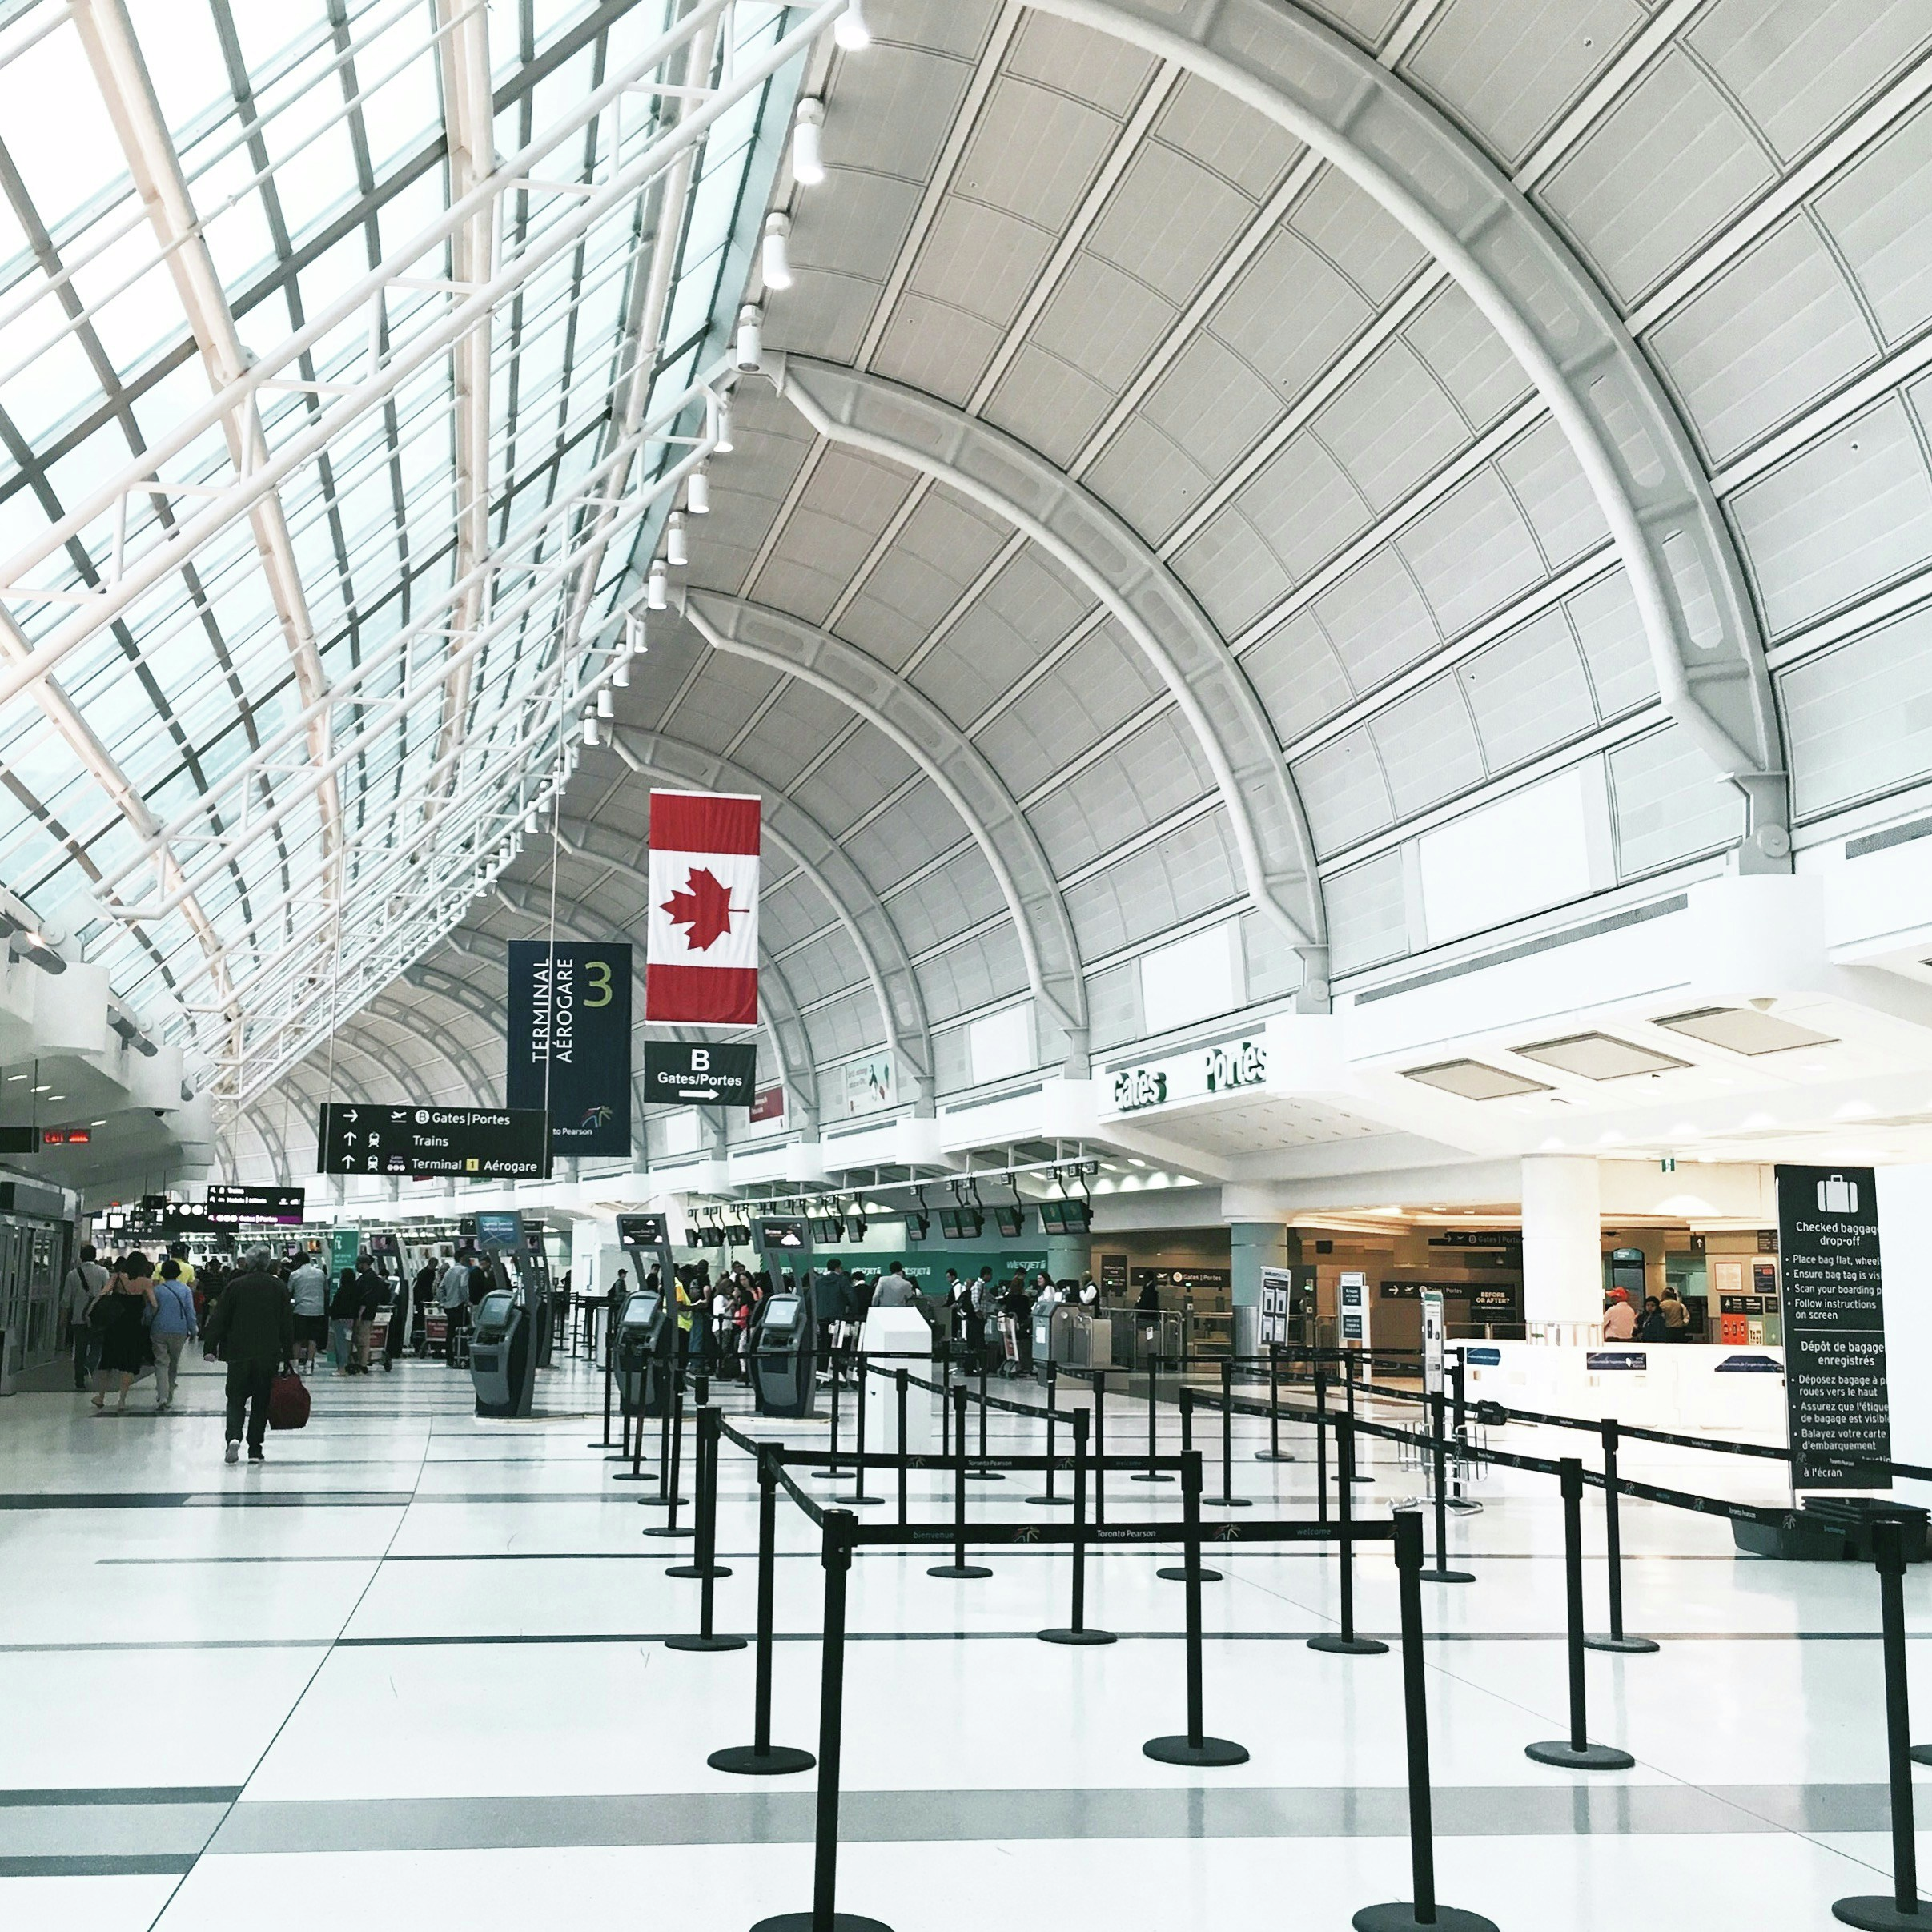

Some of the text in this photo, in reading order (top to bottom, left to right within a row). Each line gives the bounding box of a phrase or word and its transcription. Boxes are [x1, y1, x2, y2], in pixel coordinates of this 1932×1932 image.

[583, 961, 613, 1007] 3
[532, 958, 549, 1063] TERMINAL
[552, 958, 572, 1063] AÉROGARE
[691, 1048, 710, 1071] B
[657, 1072, 742, 1086] Gates/Portes
[1115, 1042, 1267, 1111] Gates Portes
[416, 1110, 510, 1125] B Gates Portes
[412, 1135, 449, 1147] Trains
[412, 1159, 462, 1171] Terminal
[468, 1160, 476, 1170] 1
[484, 1161, 538, 1173] Aérogare
[1796, 1222, 1878, 1235] Checked baggag
[1820, 1236, 1860, 1247] drop-off
[1793, 1255, 1880, 1266] Place bag flat, wheel
[1793, 1270, 1822, 1279] Ensure
[1825, 1270, 1841, 1280] bag
[1843, 1271, 1857, 1281] tag
[1859, 1271, 1866, 1279] is
[1794, 1284, 1814, 1293] Scan
[1817, 1286, 1836, 1295] your
[1838, 1285, 1874, 1296] boarding
[1794, 1299, 1877, 1309] Follow instructions
[1809, 1311, 1838, 1319] screen
[1801, 1340, 1885, 1354] Dépôt de bagage
[1818, 1355, 1875, 1368] enregistrés
[1798, 1375, 1836, 1385] Déposez
[1838, 1376, 1870, 1386] bagage
[1872, 1375, 1878, 1384] à
[1799, 1388, 1878, 1396] roues vers le haut
[1801, 1402, 1836, 1411] Assurez
[1838, 1404, 1854, 1412] que
[1801, 1414, 1812, 1423] de
[1814, 1414, 1846, 1424] bagage
[1849, 1415, 1862, 1423] est
[1801, 1428, 1886, 1440] Balayez votre carte
[1802, 1441, 1877, 1452] d'embarquement
[1803, 1468, 1842, 1477] à l'écran
[913, 1531, 954, 1539] bienvenue
[1126, 1529, 1156, 1537] Pearson
